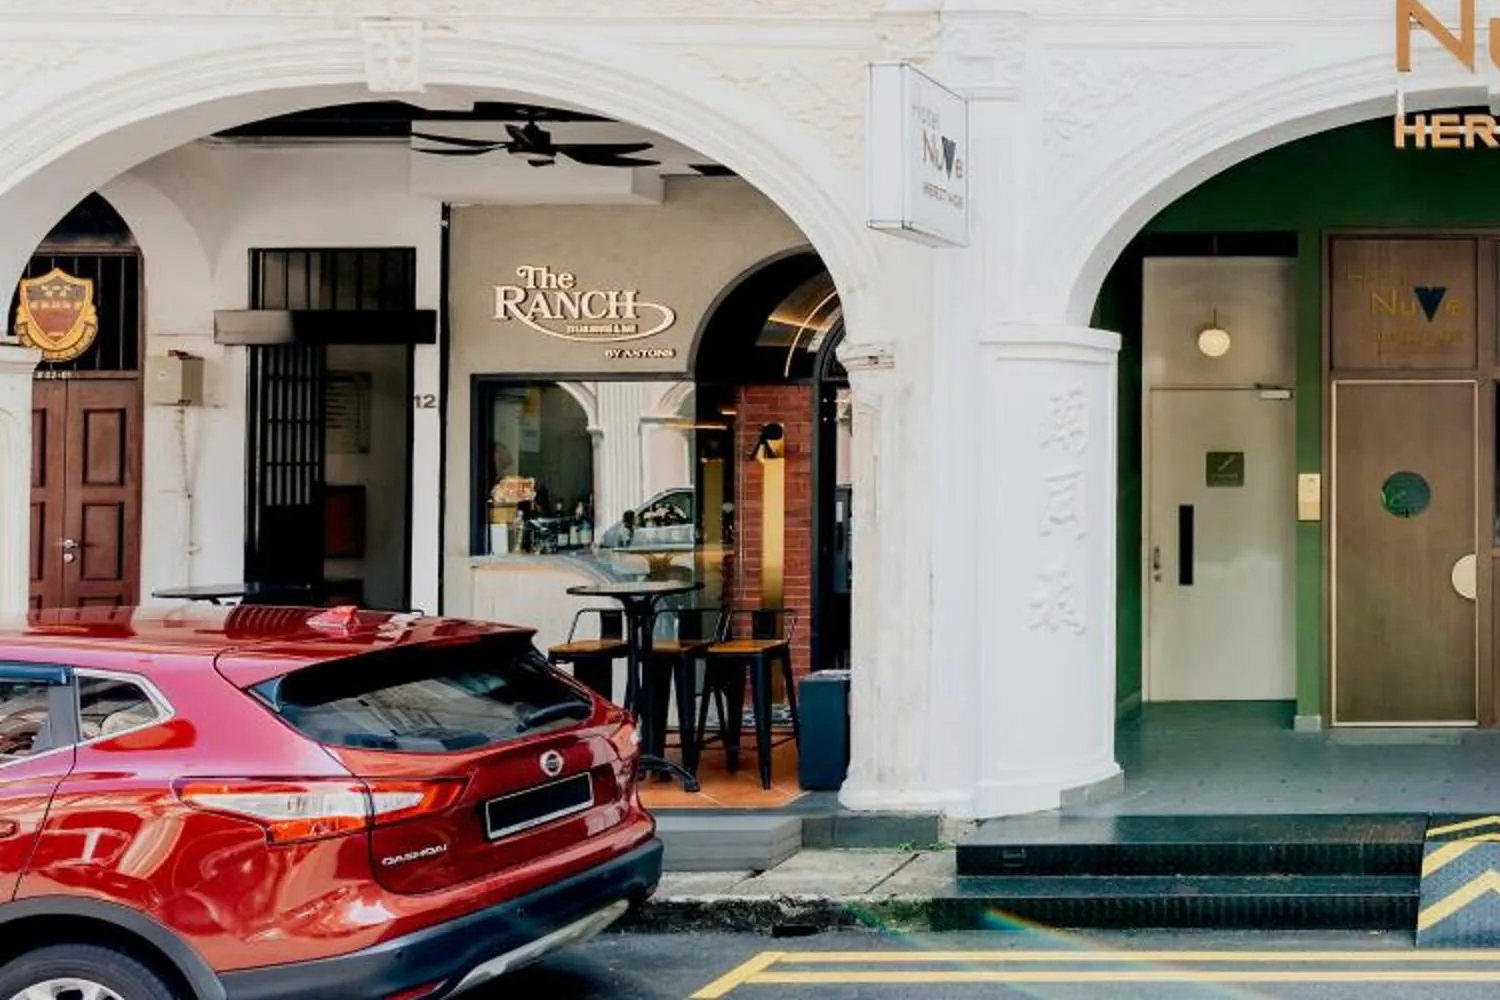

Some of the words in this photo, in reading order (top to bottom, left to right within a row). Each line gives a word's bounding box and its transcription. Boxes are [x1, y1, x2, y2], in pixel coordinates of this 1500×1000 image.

[516, 265, 577, 290] The
[494, 285, 641, 322] RANCH
[414, 393, 437, 409] 12
